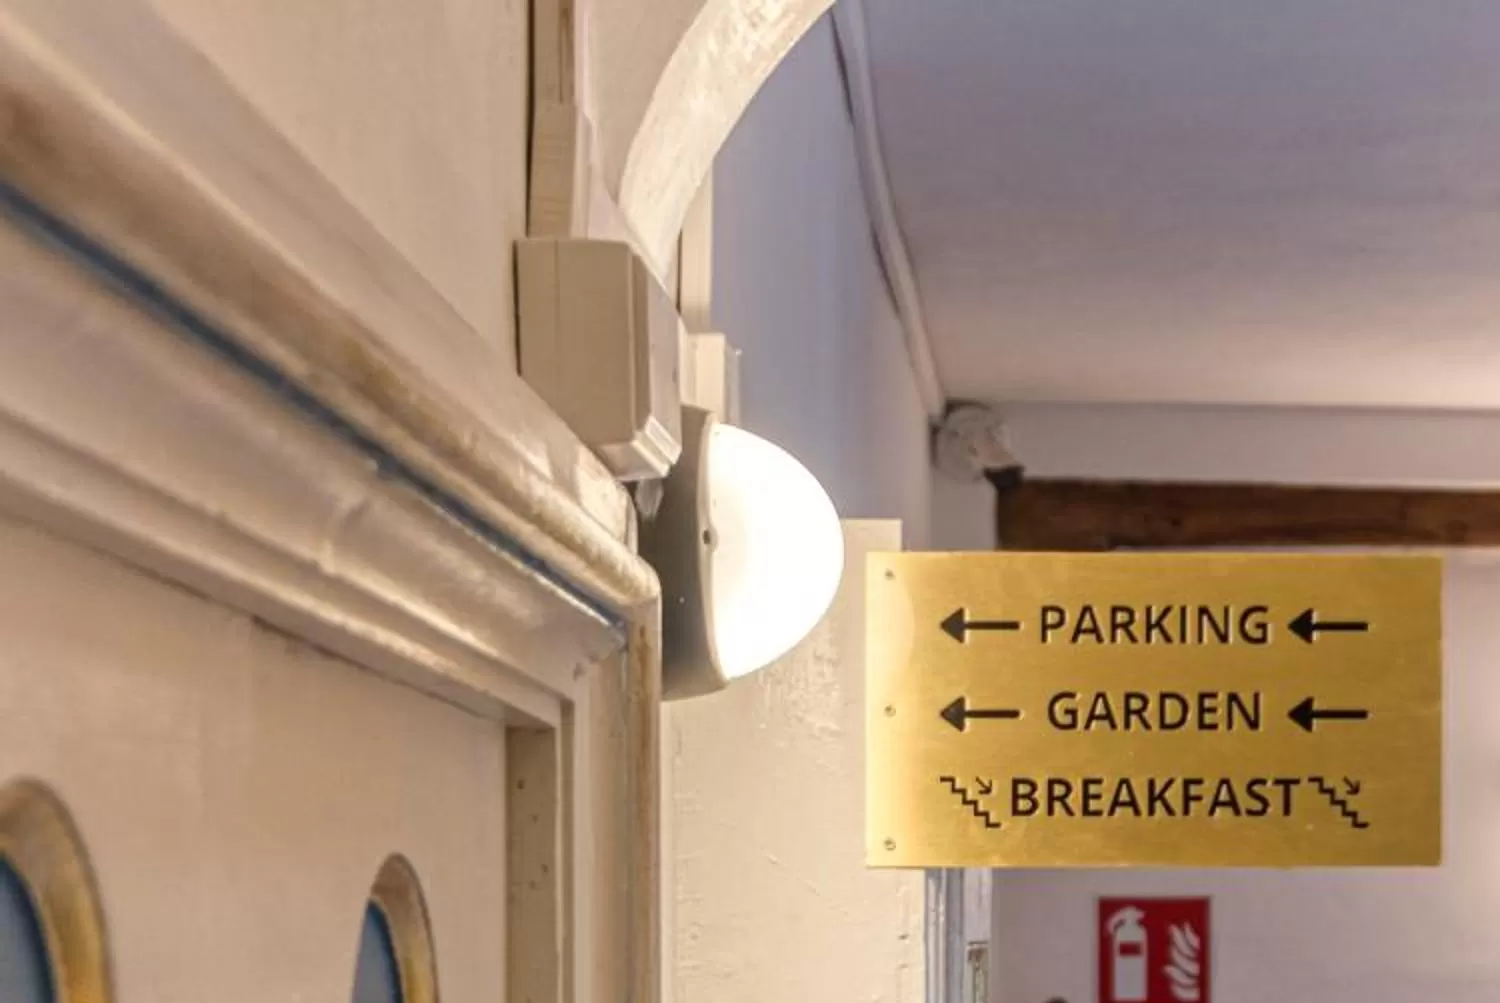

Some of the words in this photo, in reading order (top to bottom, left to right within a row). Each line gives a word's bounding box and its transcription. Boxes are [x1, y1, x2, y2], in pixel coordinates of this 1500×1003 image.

[1041, 604, 1270, 645] PARKING
[1047, 690, 1261, 731] GARDEN
[1011, 776, 1303, 818] BREAKFAST
